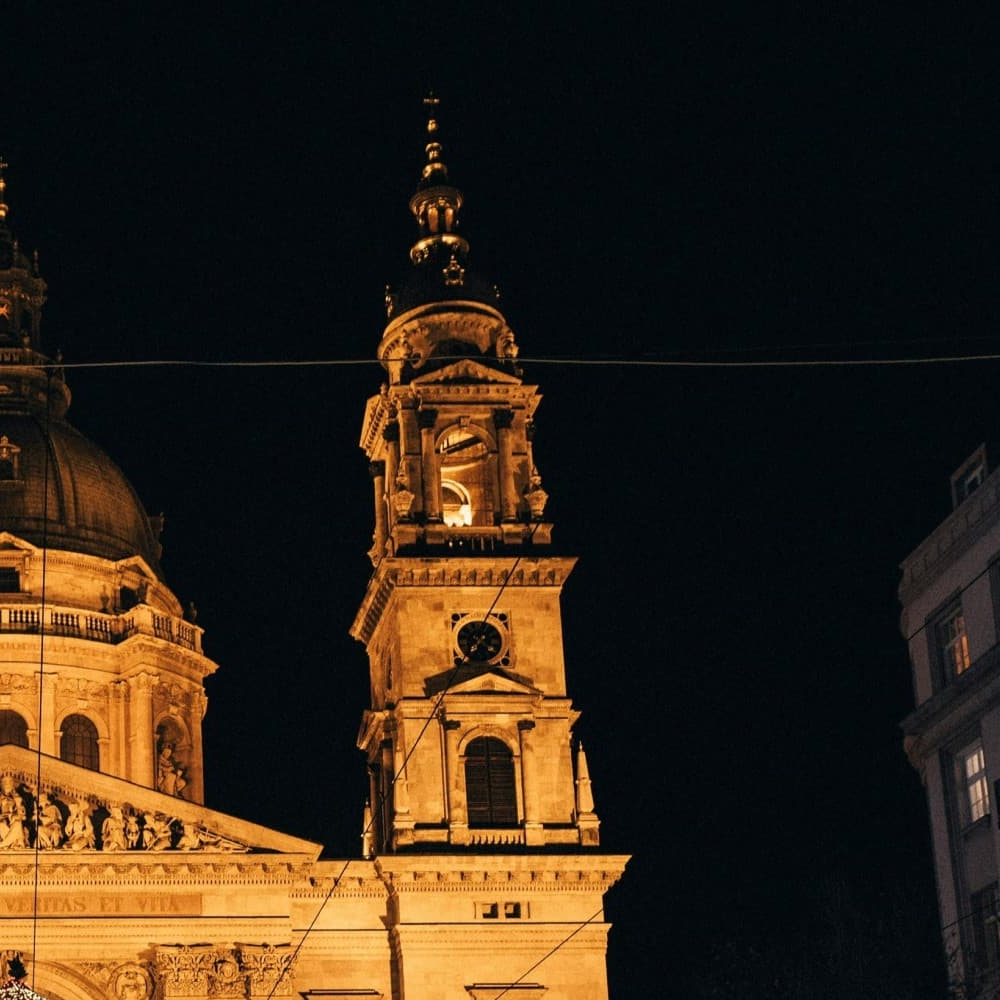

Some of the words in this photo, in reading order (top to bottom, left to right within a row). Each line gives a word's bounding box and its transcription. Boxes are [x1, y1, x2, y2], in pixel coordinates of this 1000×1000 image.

[4, 896, 87, 914] VERITAS
[99, 896, 123, 914] ET
[135, 896, 181, 914] VITA
